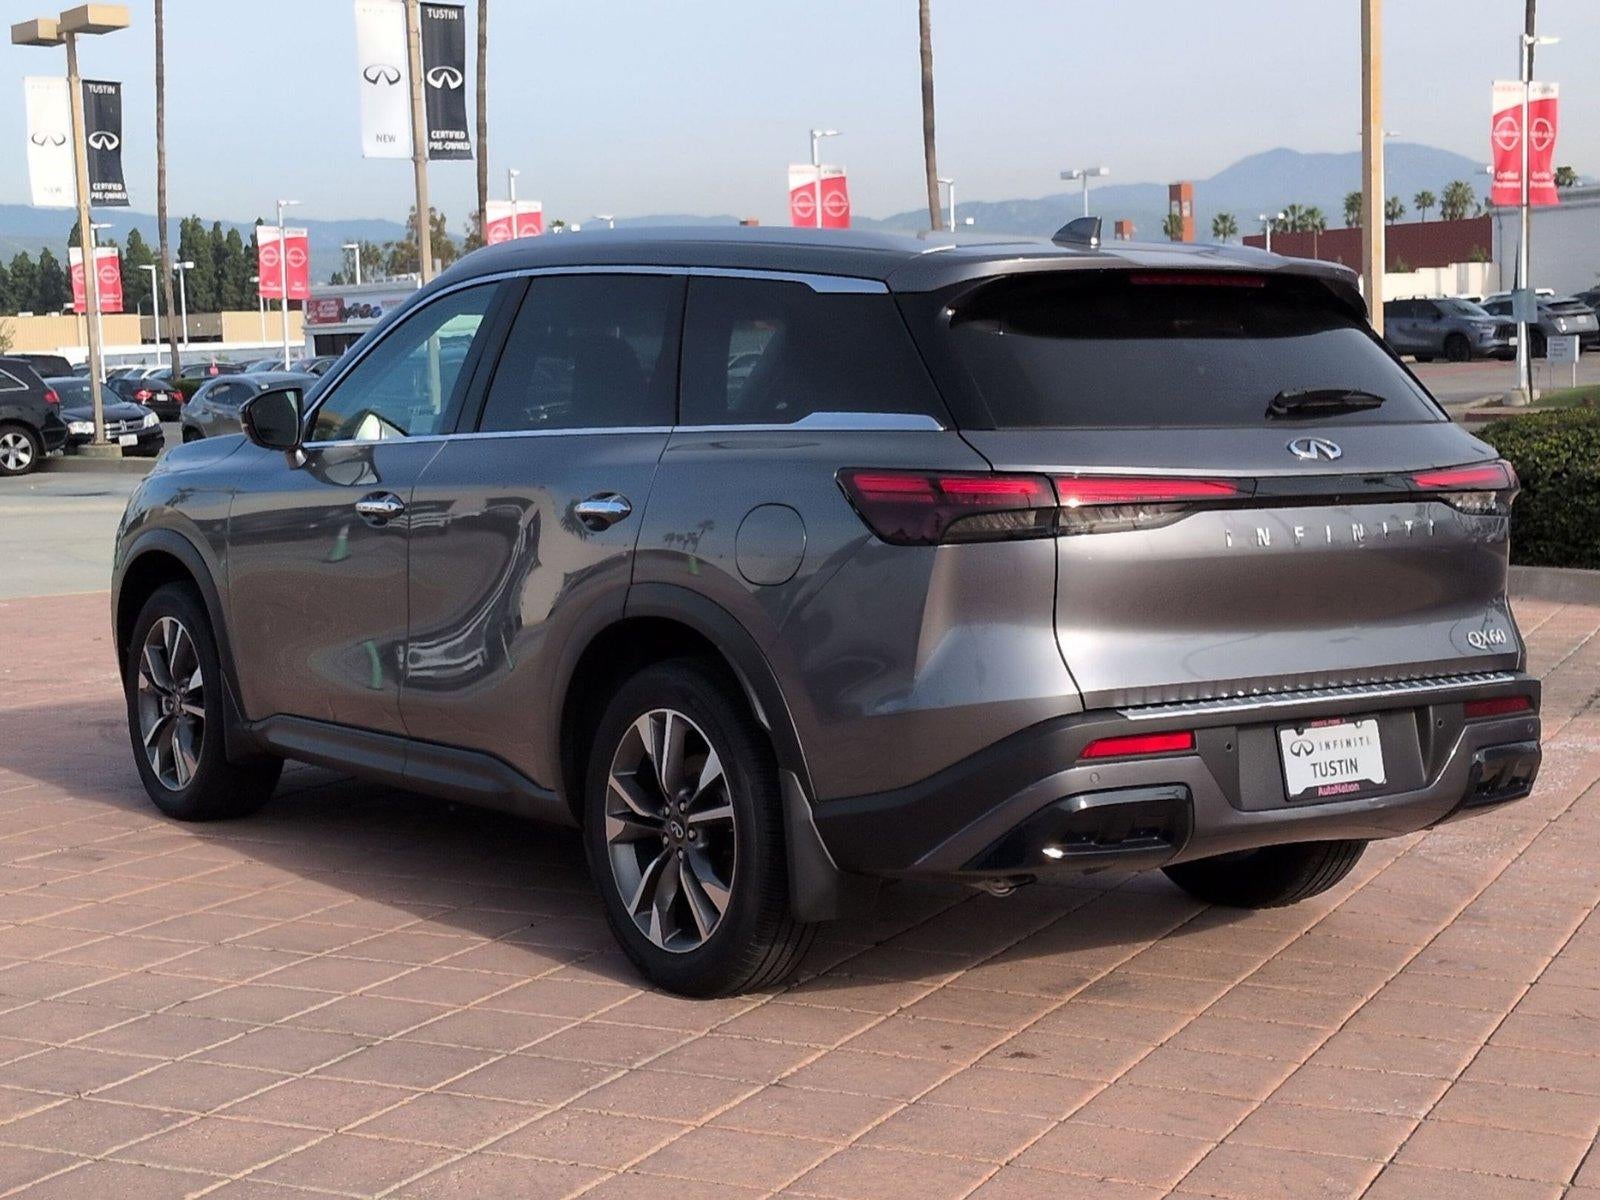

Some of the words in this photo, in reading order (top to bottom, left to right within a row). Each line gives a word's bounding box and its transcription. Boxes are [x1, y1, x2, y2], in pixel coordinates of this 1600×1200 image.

[427, 8, 458, 20] TUSTIN
[87, 84, 116, 95] TUSTIN
[376, 133, 396, 144] NEW
[431, 130, 466, 140] CERTIFIED
[429, 140, 472, 151] PRE-OWNED
[1225, 519, 1435, 547] INFINITI
[1467, 628, 1507, 650] QX60
[1319, 736, 1370, 751] INFINITI
[1311, 758, 1358, 778] TUSTIN
[1317, 782, 1360, 797] AutoNation
